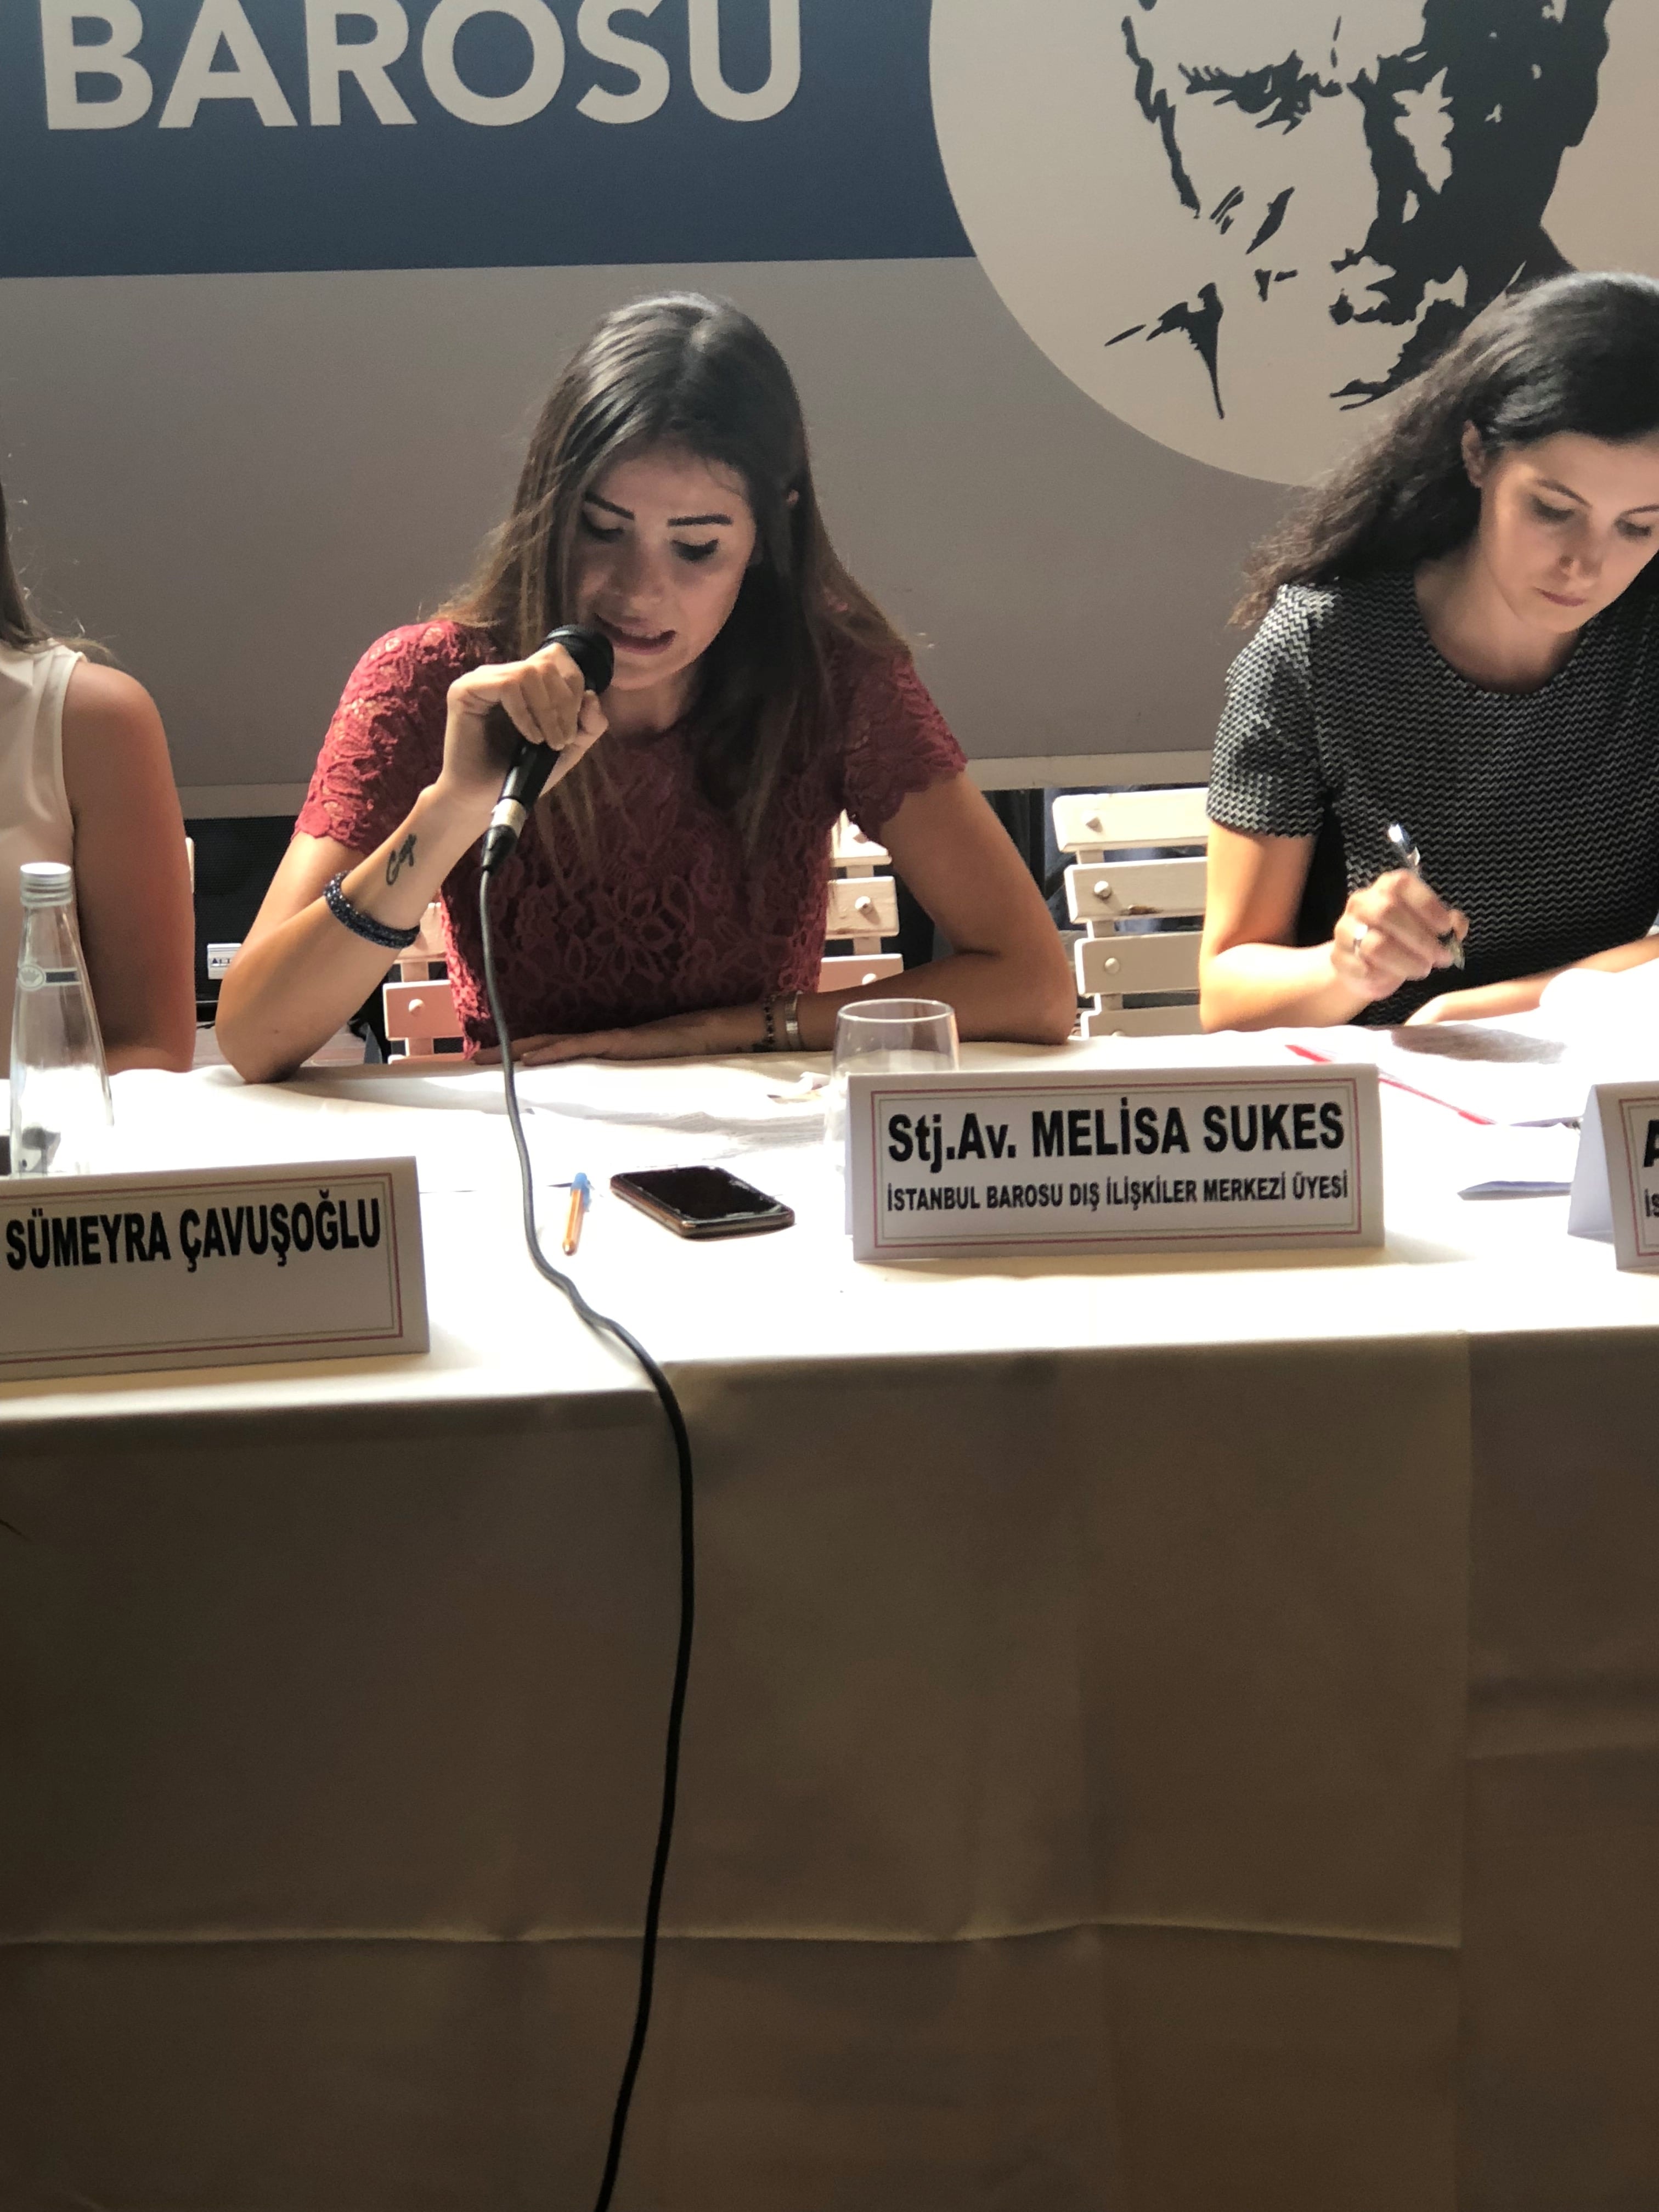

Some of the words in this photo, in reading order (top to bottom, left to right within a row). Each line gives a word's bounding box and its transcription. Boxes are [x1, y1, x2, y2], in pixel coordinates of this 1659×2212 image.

[40, 0, 802, 129] BAROSU
[888, 1112, 1017, 1174] Stj.Av.
[1031, 1096, 1190, 1158] MELİSA
[1202, 1101, 1345, 1154] SUKES
[5, 1207, 172, 1271] SÜMEYRA
[179, 1188, 381, 1273] ÇAVUŞOĞLU
[887, 1182, 981, 1212] İSTANBUL
[986, 1183, 1063, 1209] BAROSU
[1069, 1181, 1101, 1212] DIŞ
[1105, 1173, 1198, 1211] İLİŞKİLER
[1203, 1170, 1286, 1203] MERKEZİ
[1292, 1169, 1348, 1200] ÜYESİ
